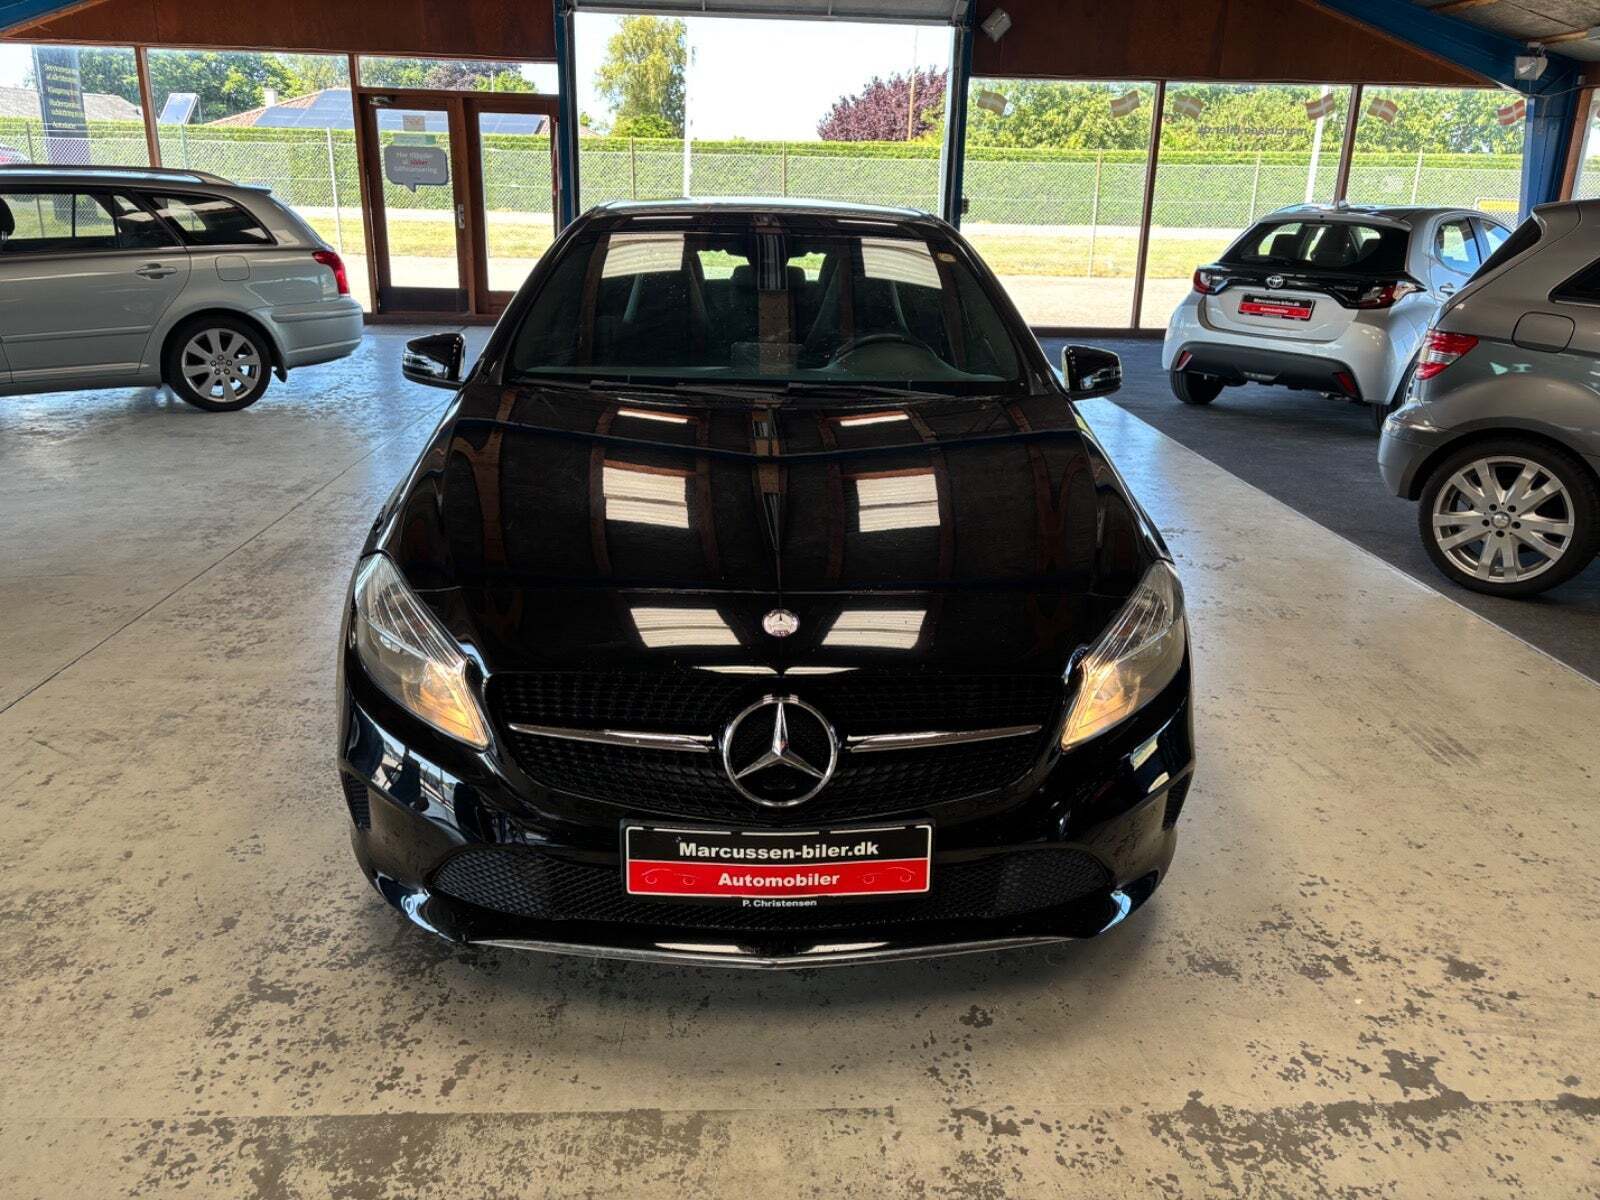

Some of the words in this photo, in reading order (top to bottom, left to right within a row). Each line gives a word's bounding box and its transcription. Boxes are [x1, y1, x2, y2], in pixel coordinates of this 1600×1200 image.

[679, 841, 879, 859] Marcussen-biler.dk
[718, 872, 840, 887] Automobiler
[754, 899, 817, 908] Christensen
